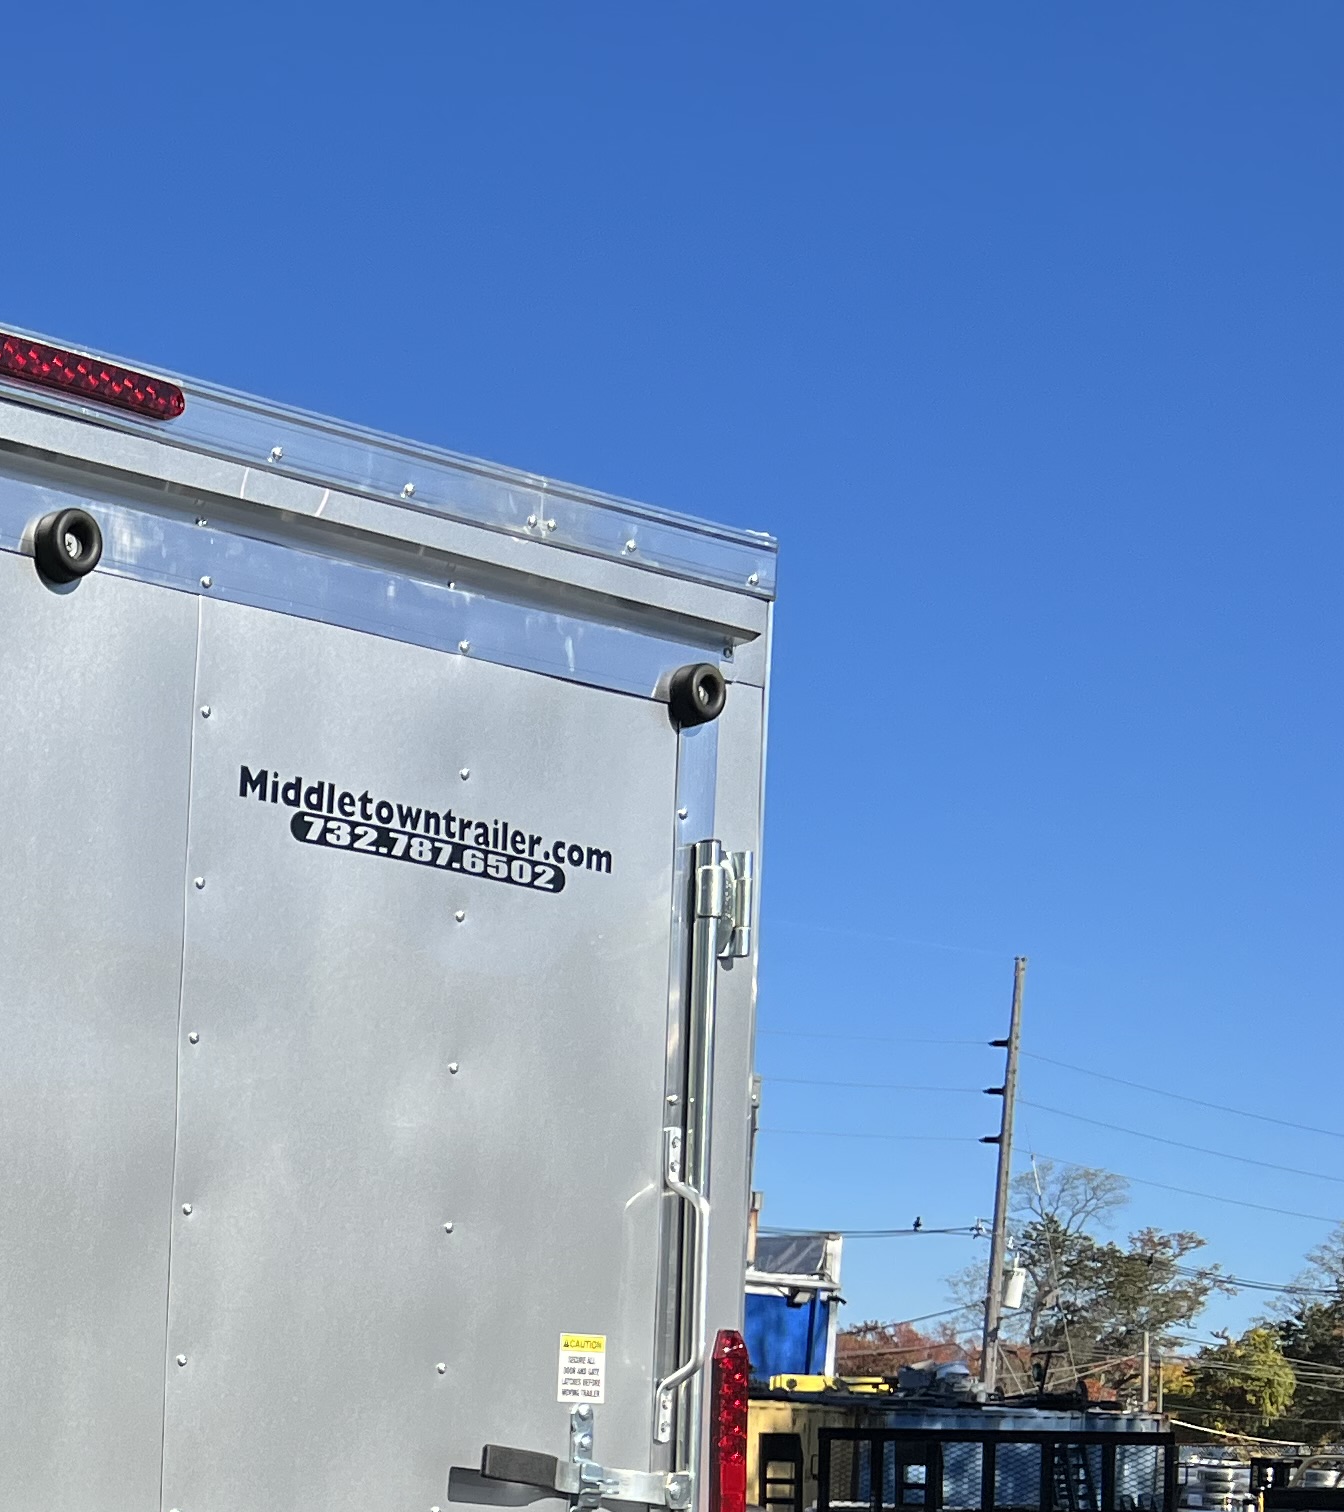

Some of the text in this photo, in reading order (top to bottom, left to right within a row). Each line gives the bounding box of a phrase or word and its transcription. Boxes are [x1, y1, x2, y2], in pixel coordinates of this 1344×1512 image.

[238, 764, 613, 874] Middletowntrailer.com
[301, 815, 557, 891] 732.787.6502
[569, 1340, 601, 1350] CAUTION
